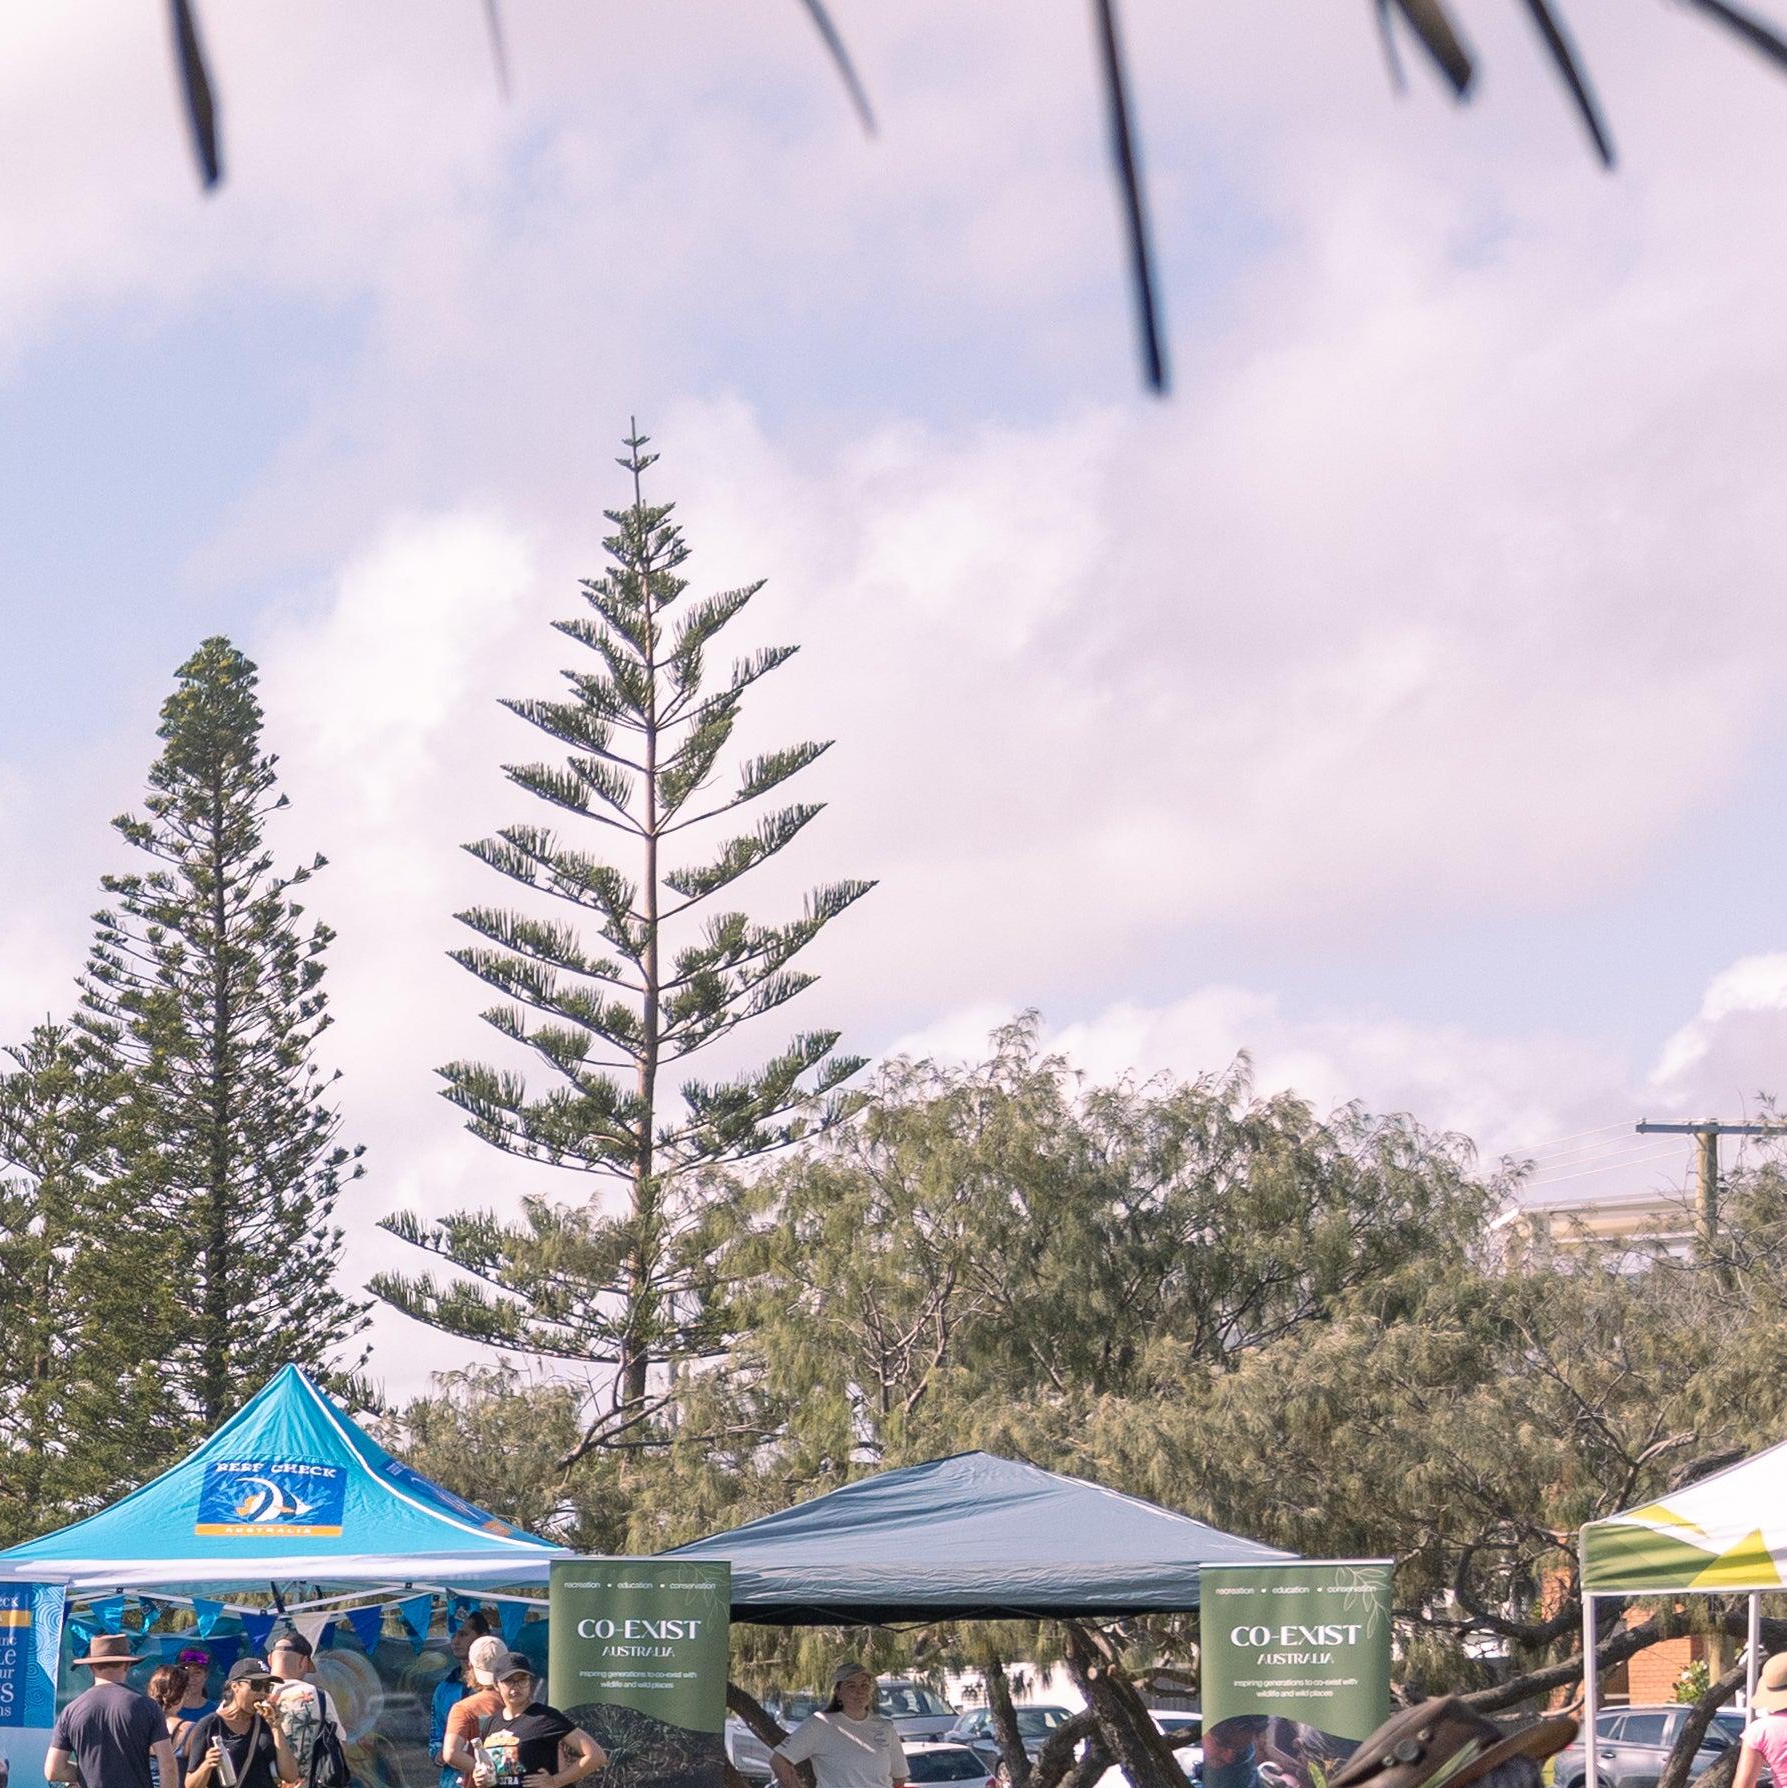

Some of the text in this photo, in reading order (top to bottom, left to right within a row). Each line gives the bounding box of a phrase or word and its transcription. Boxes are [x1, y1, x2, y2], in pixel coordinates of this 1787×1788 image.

[215, 1462, 337, 1478] REEF CHECK
[617, 1581, 653, 1589] education
[1272, 1586, 1310, 1595] education
[577, 1618, 702, 1640] CO-EXIST
[1230, 1624, 1362, 1647] CO-EXIST
[602, 1645, 676, 1658] AUSTRALIA
[1256, 1652, 1335, 1665] AUSTRALIA
